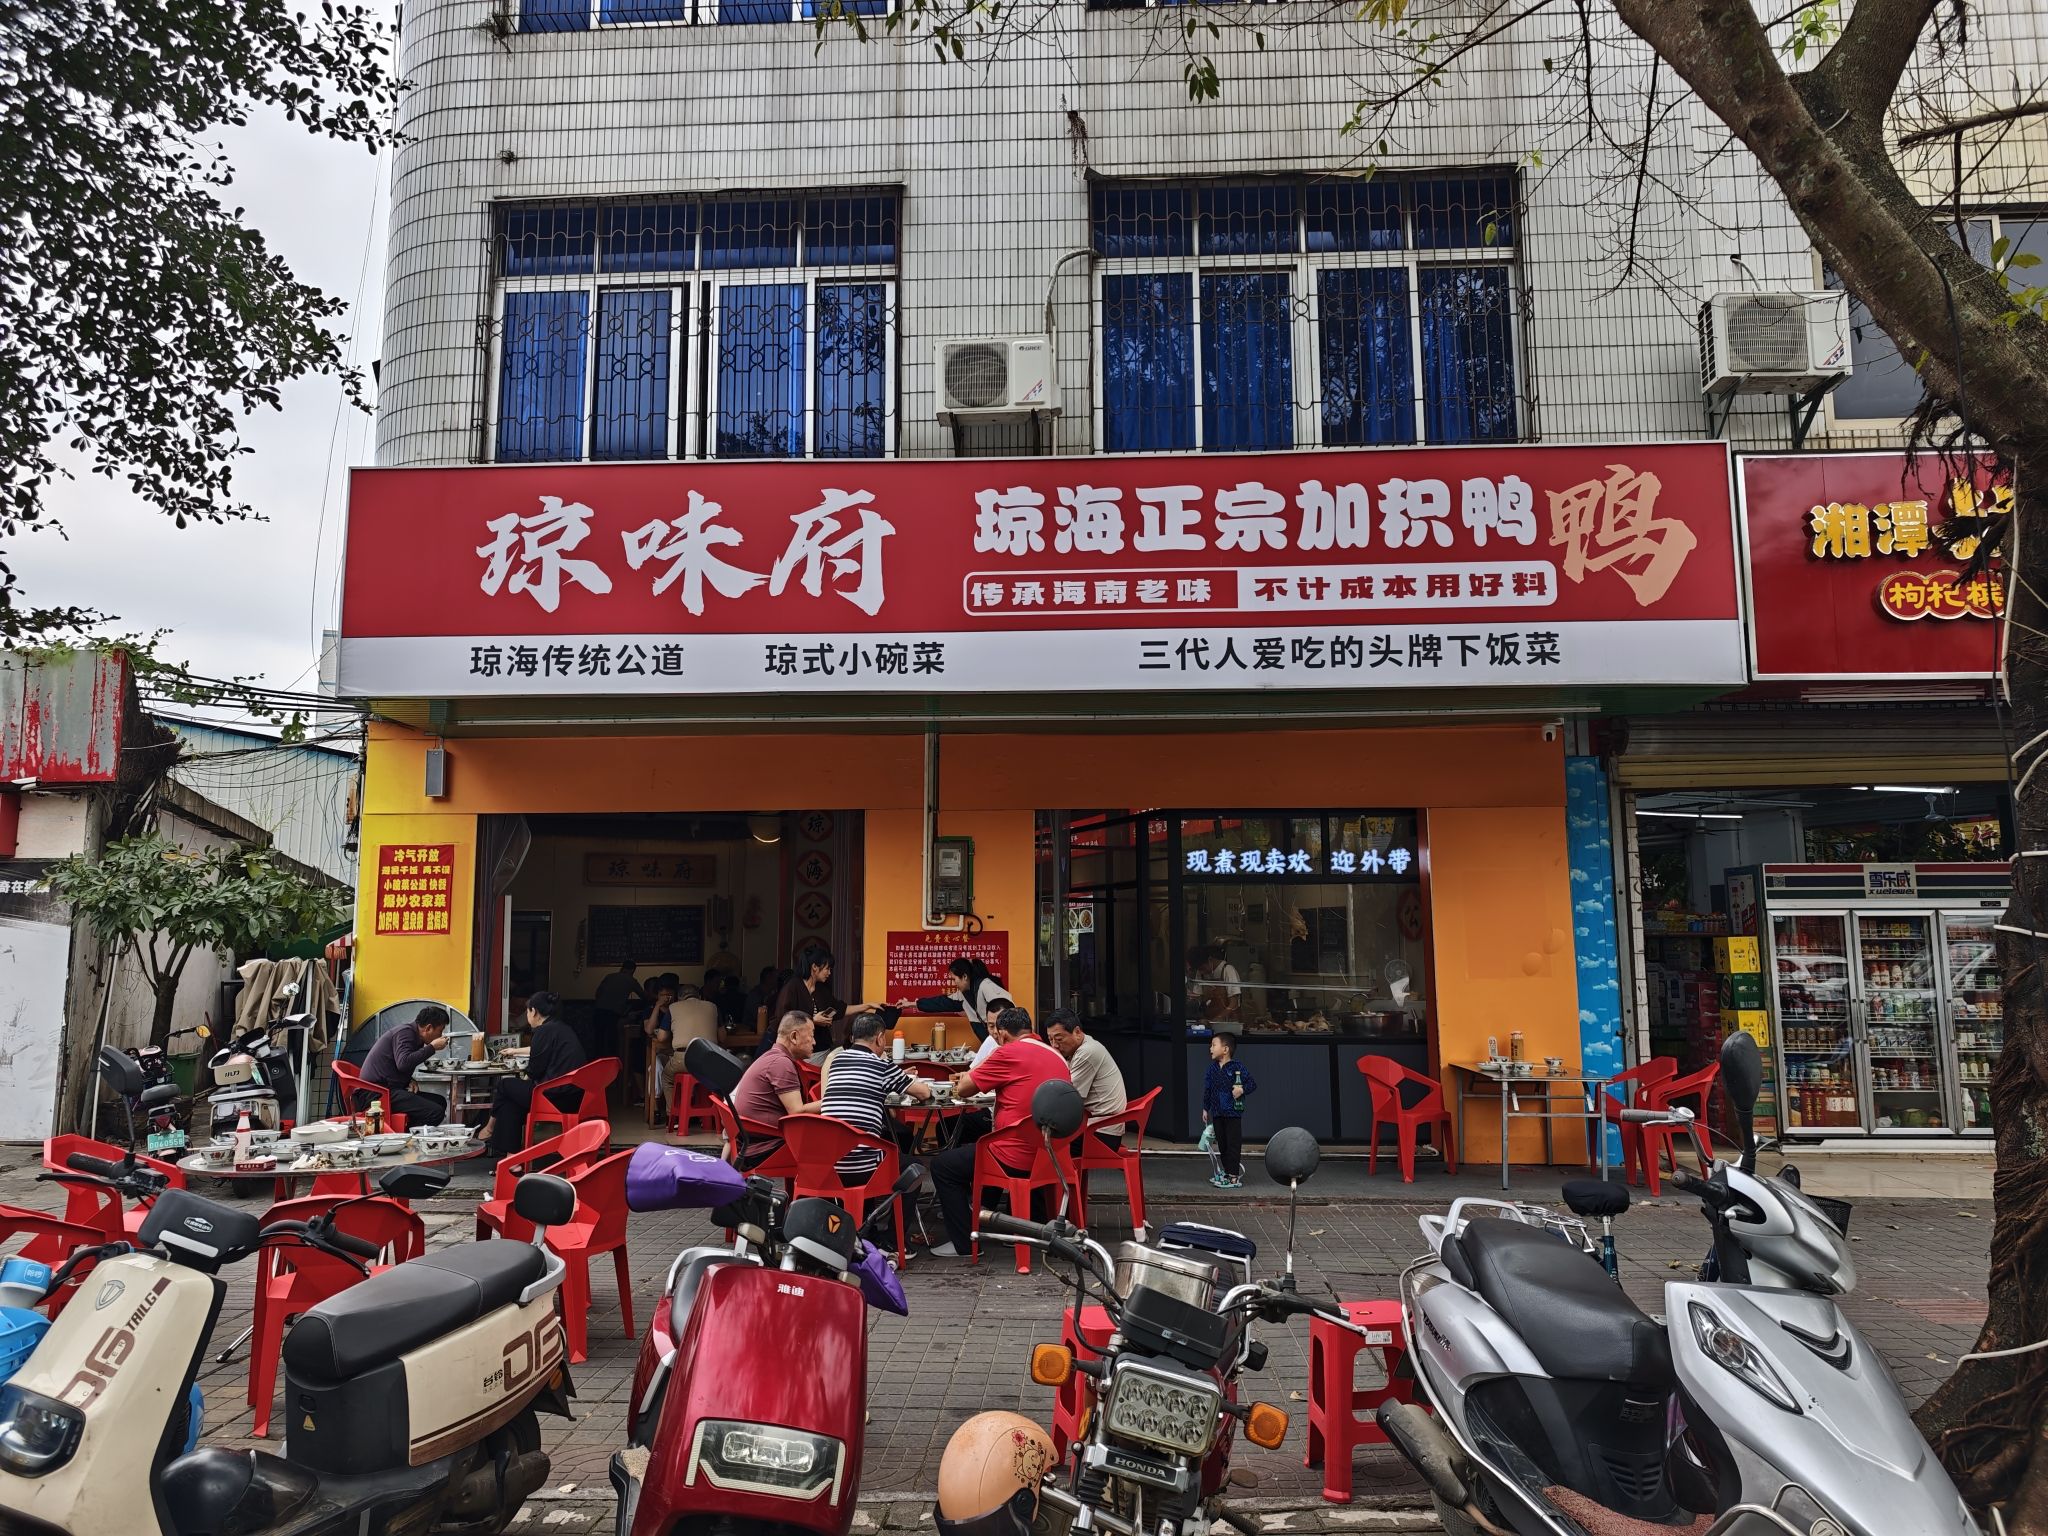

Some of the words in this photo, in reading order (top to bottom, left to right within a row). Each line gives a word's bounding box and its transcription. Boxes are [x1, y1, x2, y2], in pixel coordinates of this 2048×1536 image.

[973, 473, 1539, 556] 琼海正宗加积鸭
[474, 487, 897, 617] 琼味府
[1547, 464, 1697, 607] 鸭
[970, 574, 1213, 607] 传承海南老味
[1254, 570, 1548, 602] 不计成本用好料
[469, 642, 685, 677] 琼海传统公道
[764, 641, 945, 676] 琼式小碗菜
[1138, 630, 1562, 671] 三代人爱吃的头牌下饭菜
[394, 848, 440, 863] 冷气开放
[1186, 847, 1313, 875] 现煮现卖欢
[1330, 847, 1412, 875] 迎外带
[777, 1283, 805, 1297] 雅迪
[125, 1291, 158, 1331] TAILG
[1113, 1456, 1168, 1478] HONDA
